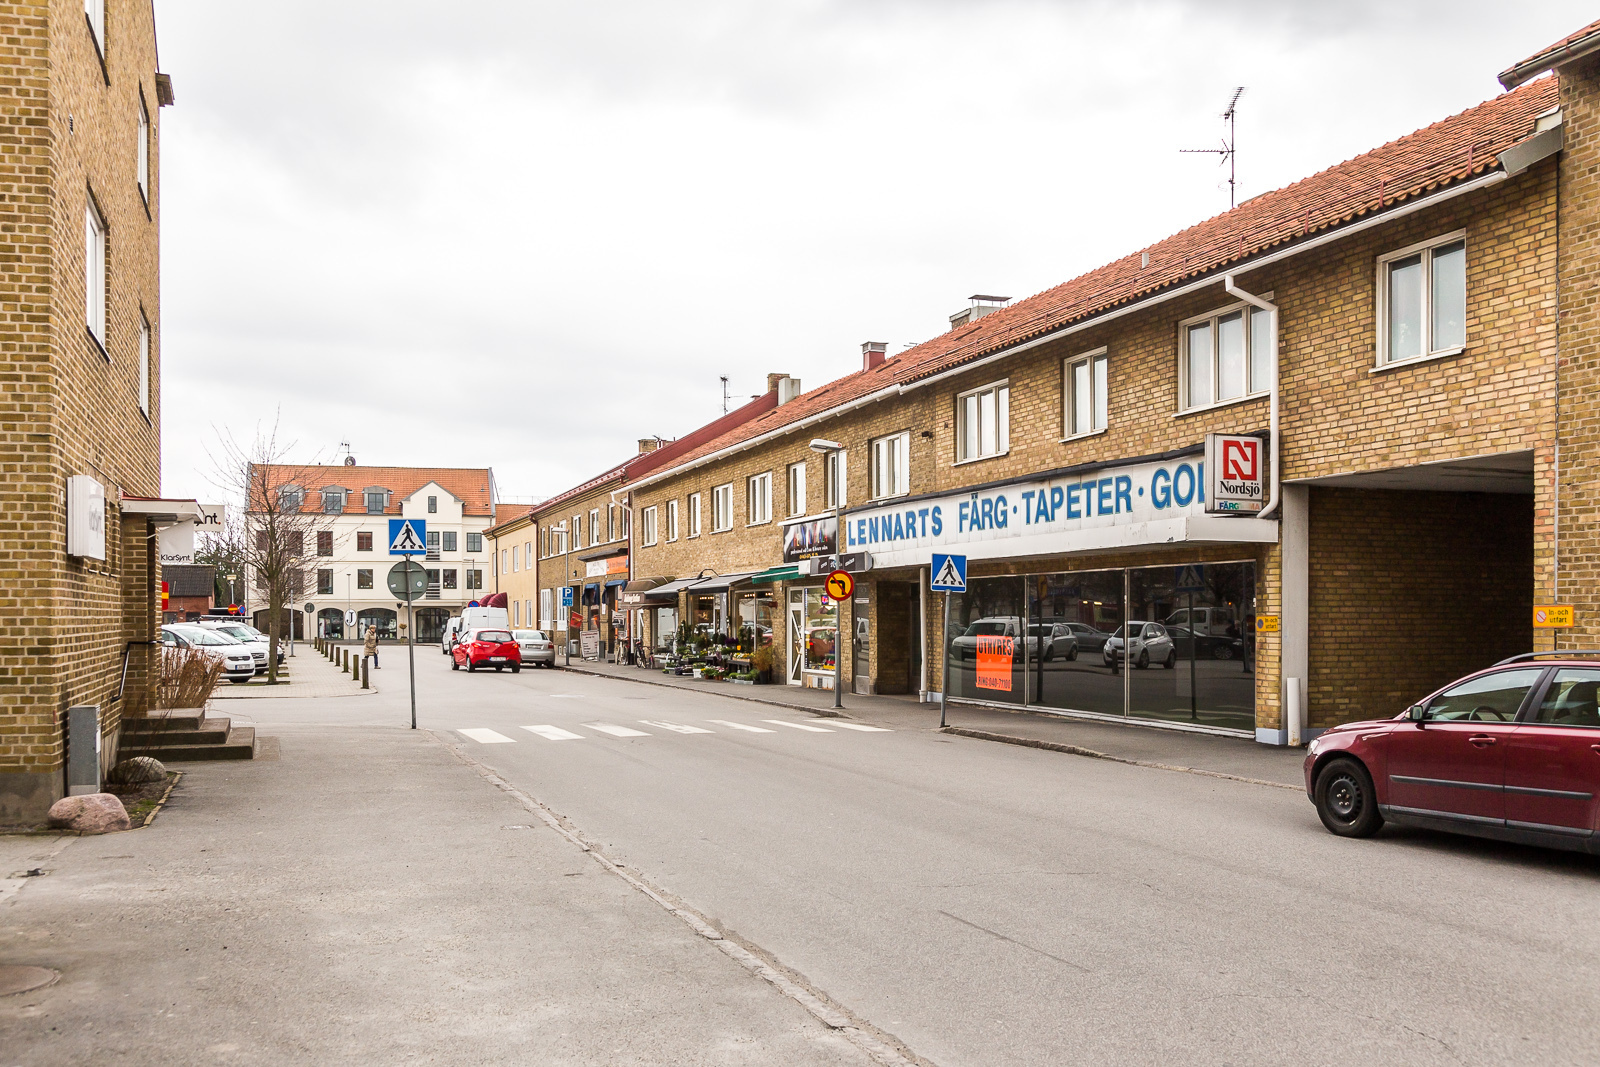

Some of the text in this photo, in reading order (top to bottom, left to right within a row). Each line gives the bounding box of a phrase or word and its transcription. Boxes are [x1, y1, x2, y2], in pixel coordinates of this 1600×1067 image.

[1219, 480, 1261, 498] Nordsjö
[848, 505, 942, 547] LENNARTS
[958, 492, 1009, 534] FÄRG
[1021, 474, 1133, 526] TAPETER
[564, 588, 572, 597] P
[978, 637, 1013, 657] UTHYRES
